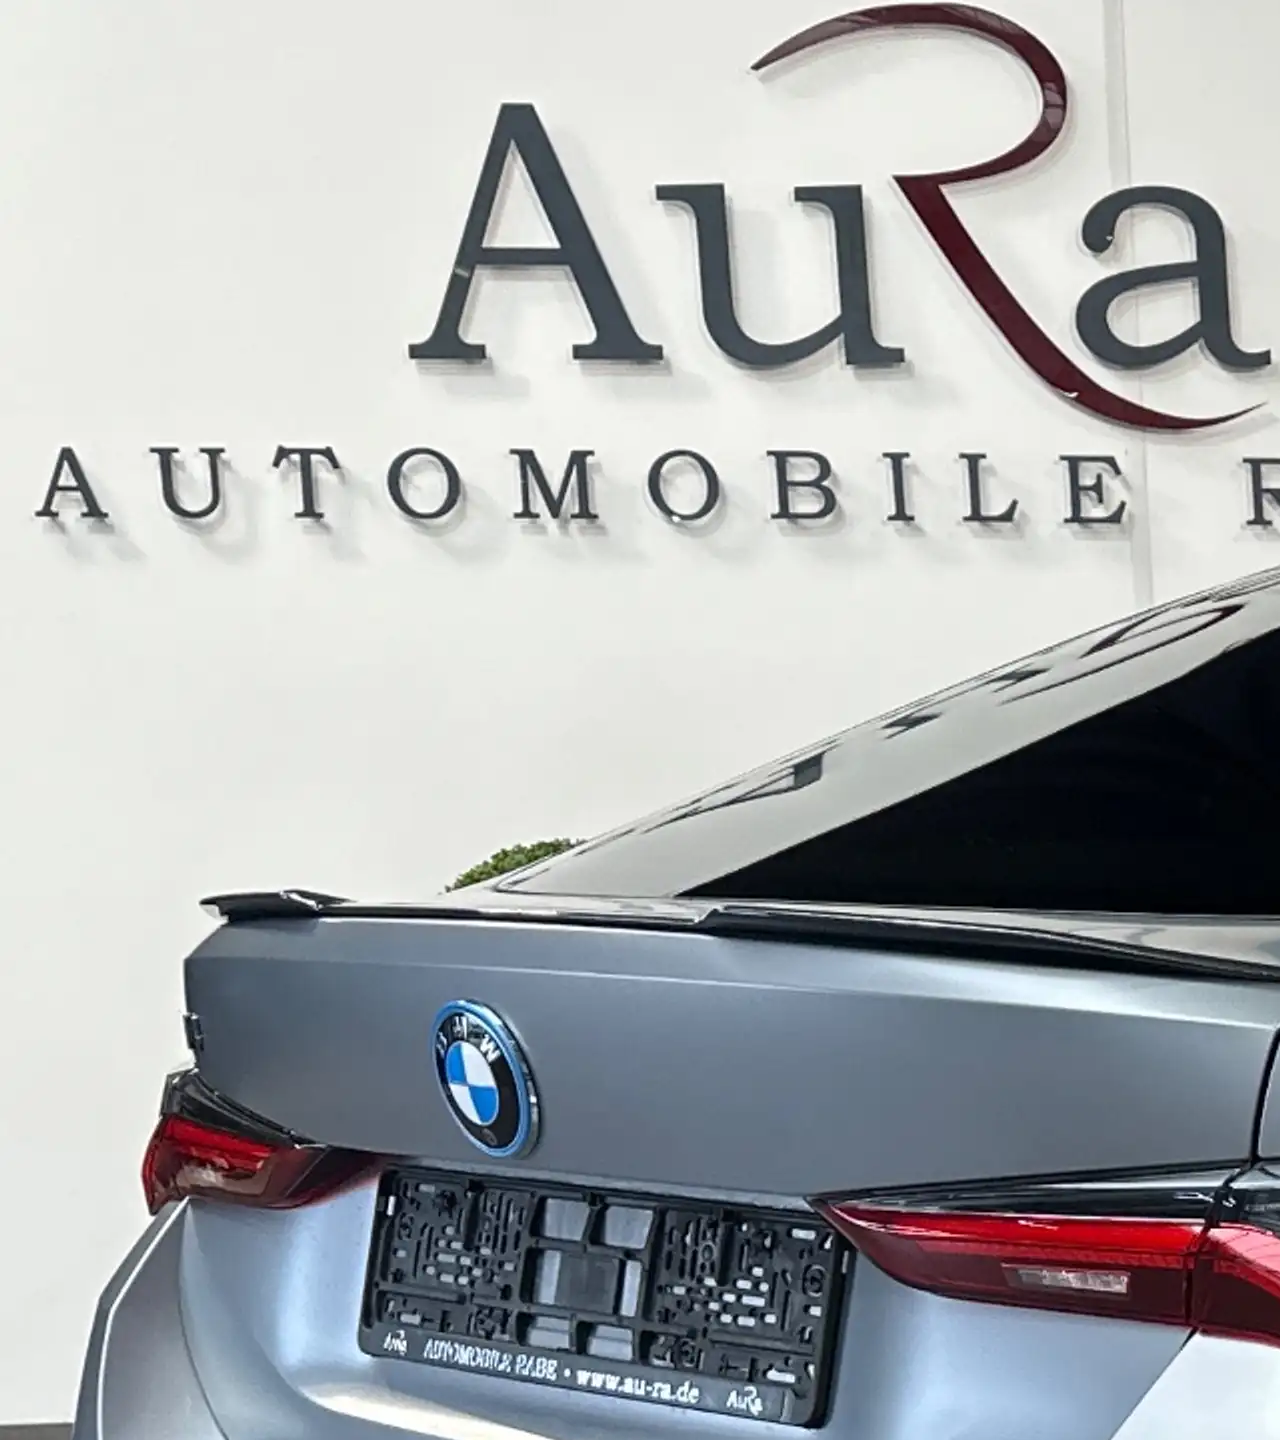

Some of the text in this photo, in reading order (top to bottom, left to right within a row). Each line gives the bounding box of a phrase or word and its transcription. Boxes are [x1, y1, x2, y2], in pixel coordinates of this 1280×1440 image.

[35, 445, 1128, 525] AUTOMOBILE
[515, 1353, 559, 1382] RABE
[575, 1368, 700, 1405] www.au-ra.de
